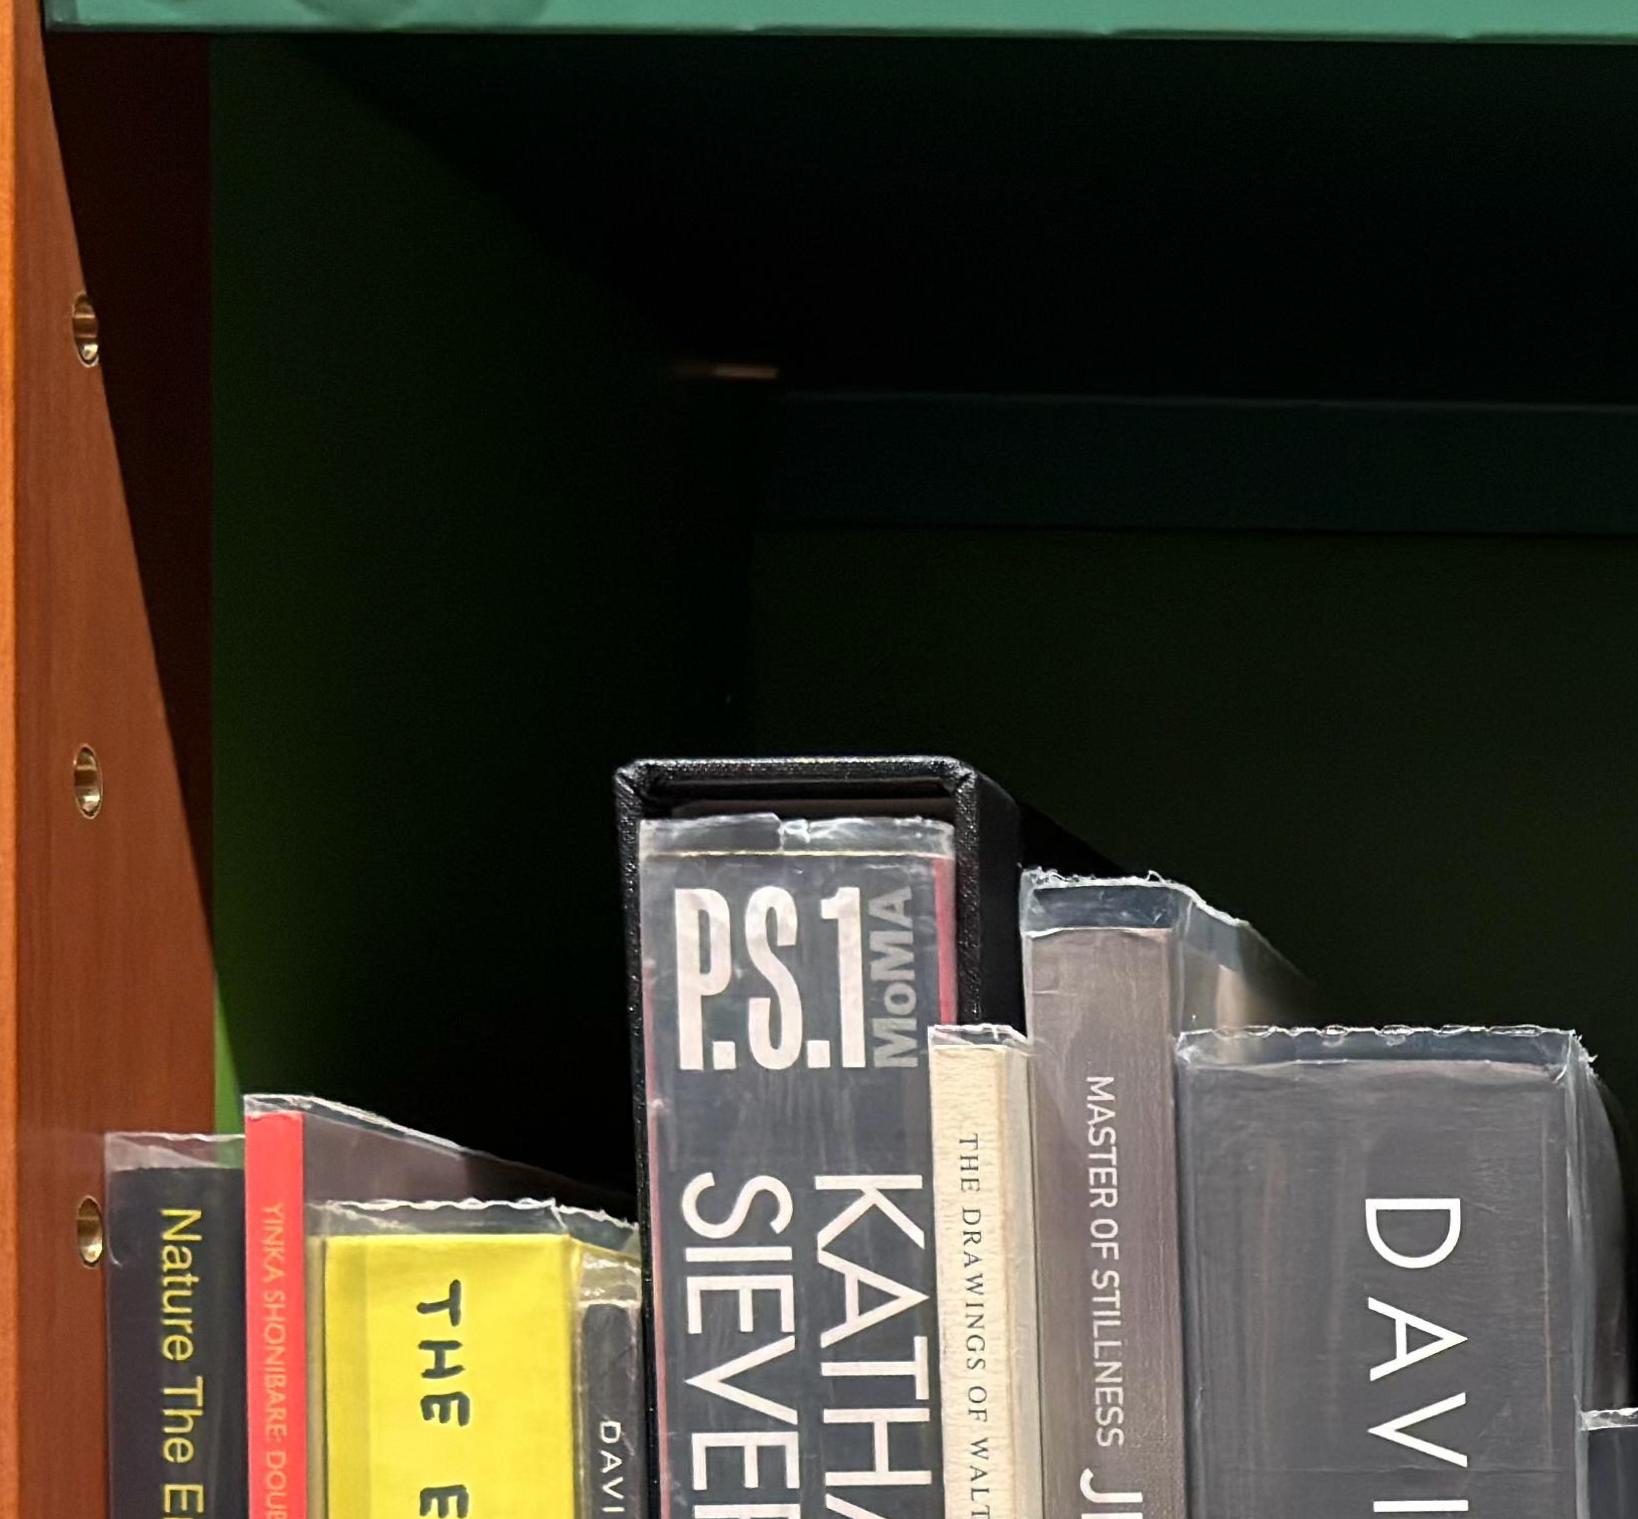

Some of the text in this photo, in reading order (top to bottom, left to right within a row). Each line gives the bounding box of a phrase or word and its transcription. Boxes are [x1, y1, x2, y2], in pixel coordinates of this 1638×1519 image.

[674, 887, 865, 1071] P.S.1
[868, 888, 919, 1068] MoMA
[959, 1133, 979, 1192] THE
[162, 1209, 202, 1360] Nature
[264, 1204, 284, 1281] YINKA
[963, 1208, 985, 1369] DRAWINGS
[1087, 1077, 1124, 1446] MASTER OF STILLNESS
[163, 1376, 203, 1463] The
[263, 1290, 288, 1442] SHONIBARE:
[417, 1279, 469, 1426] THE
[968, 1386, 987, 1422] OF
